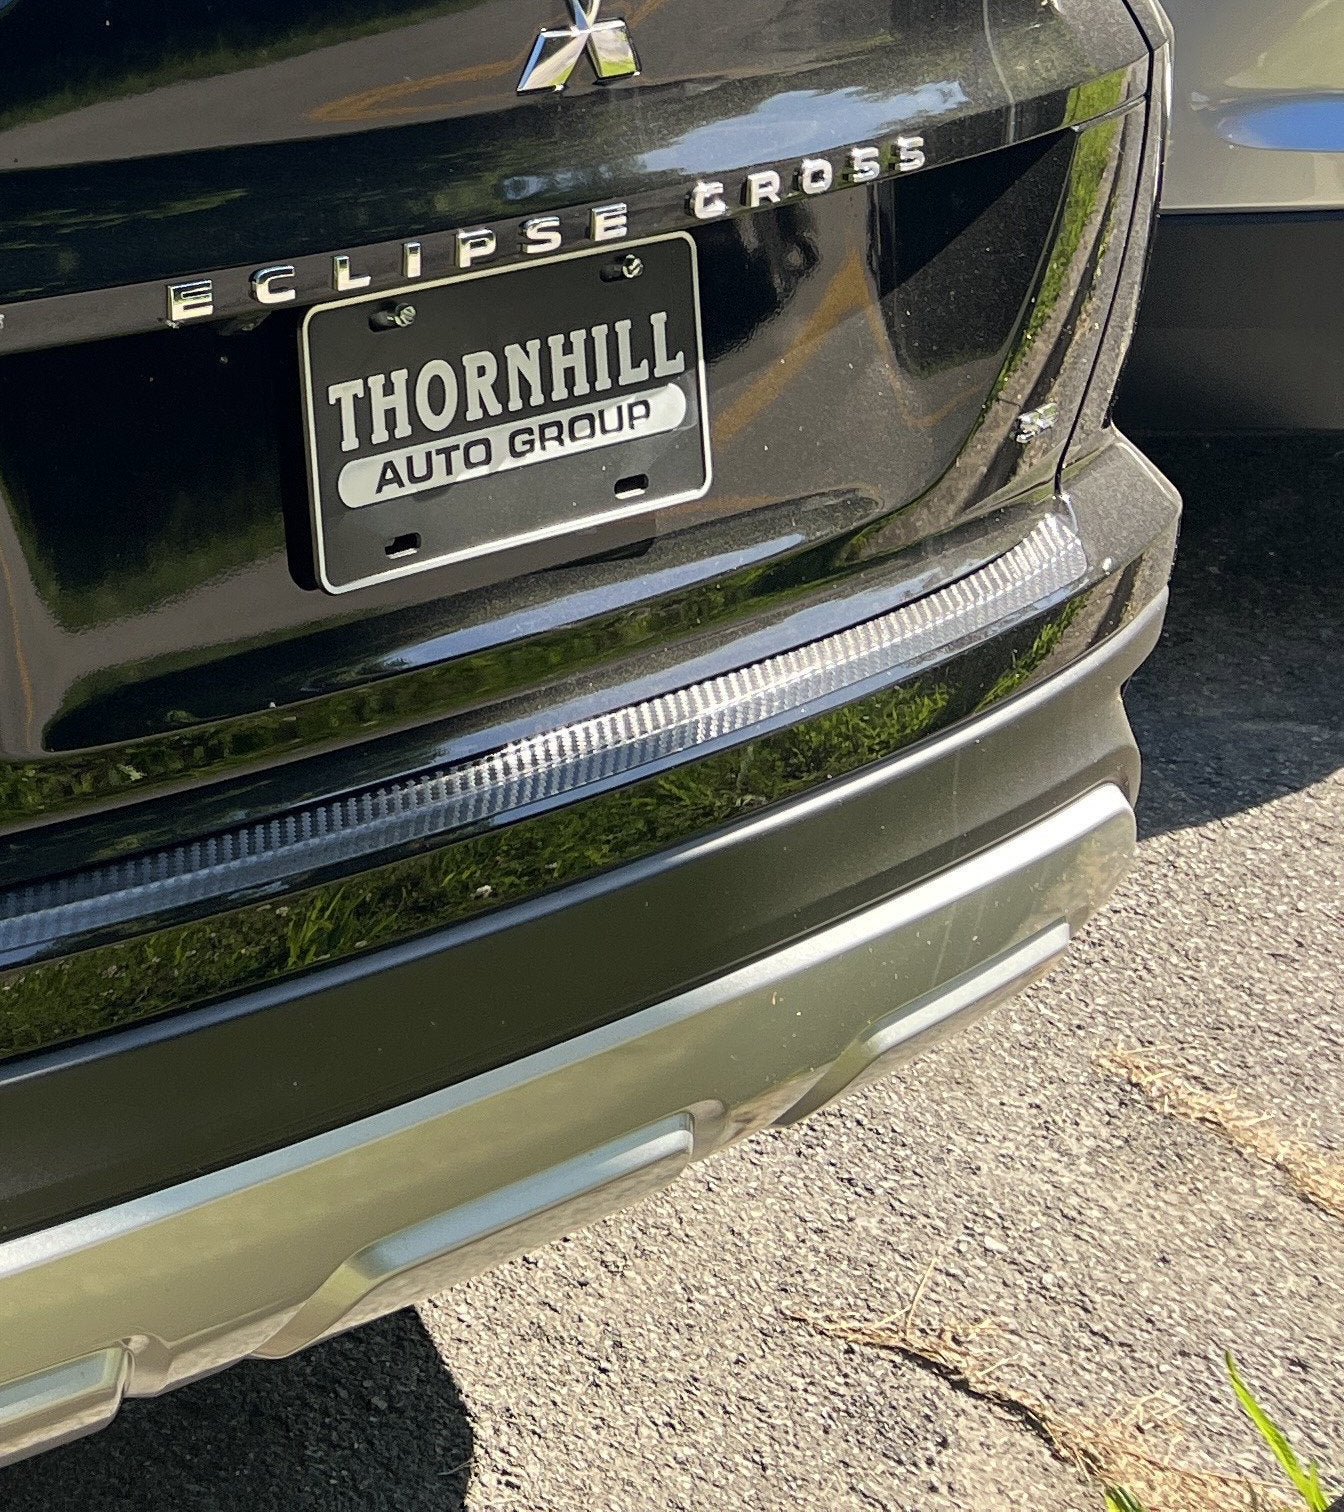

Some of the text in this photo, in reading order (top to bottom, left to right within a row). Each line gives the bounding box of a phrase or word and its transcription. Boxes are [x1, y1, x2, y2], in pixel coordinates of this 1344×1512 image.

[166, 136, 927, 323] ECLIPSE CROSS
[327, 311, 686, 452] THORNHILL
[374, 399, 652, 495] AUTO GROUP
